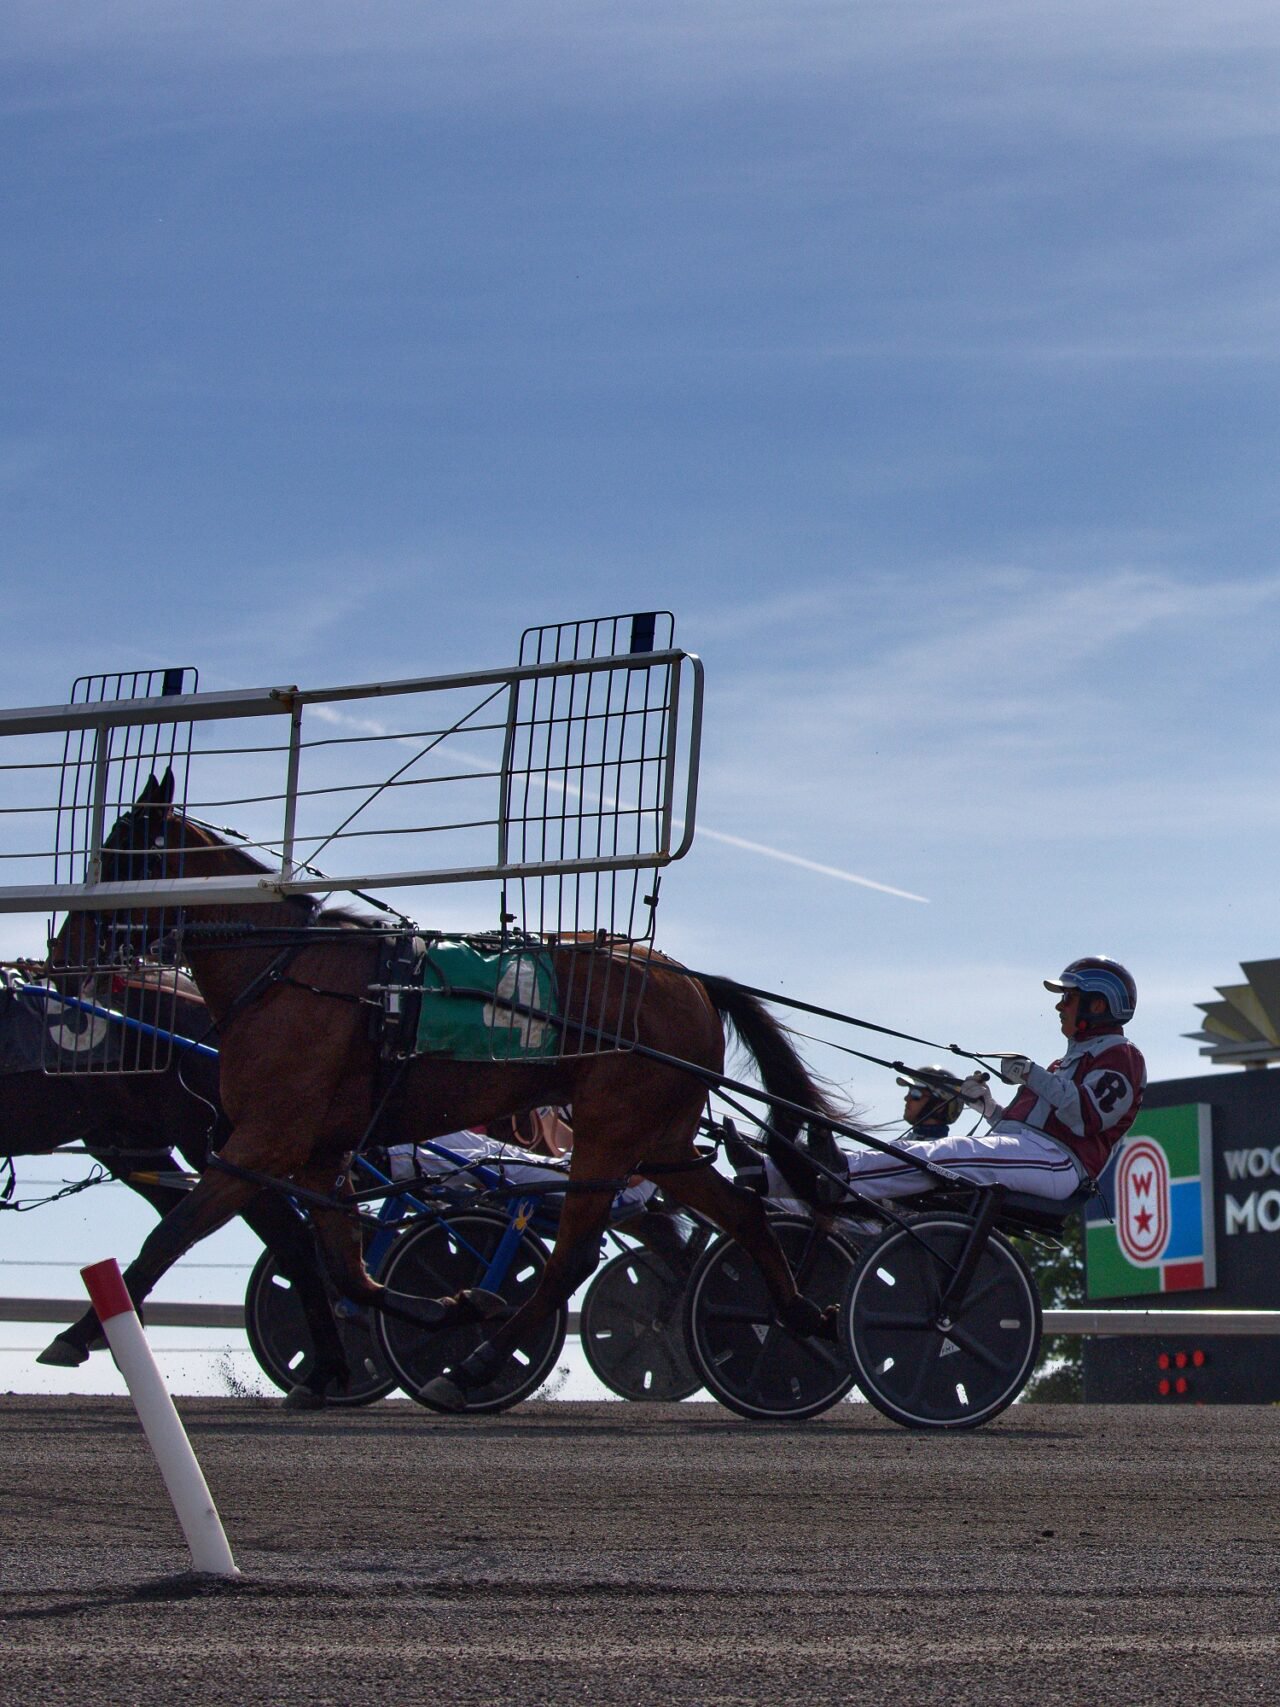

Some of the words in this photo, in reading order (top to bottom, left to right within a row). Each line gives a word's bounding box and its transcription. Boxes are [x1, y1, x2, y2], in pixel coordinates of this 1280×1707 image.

[483, 957, 552, 1048] 4
[1095, 1071, 1128, 1114] R
[1132, 1171, 1153, 1197] W
